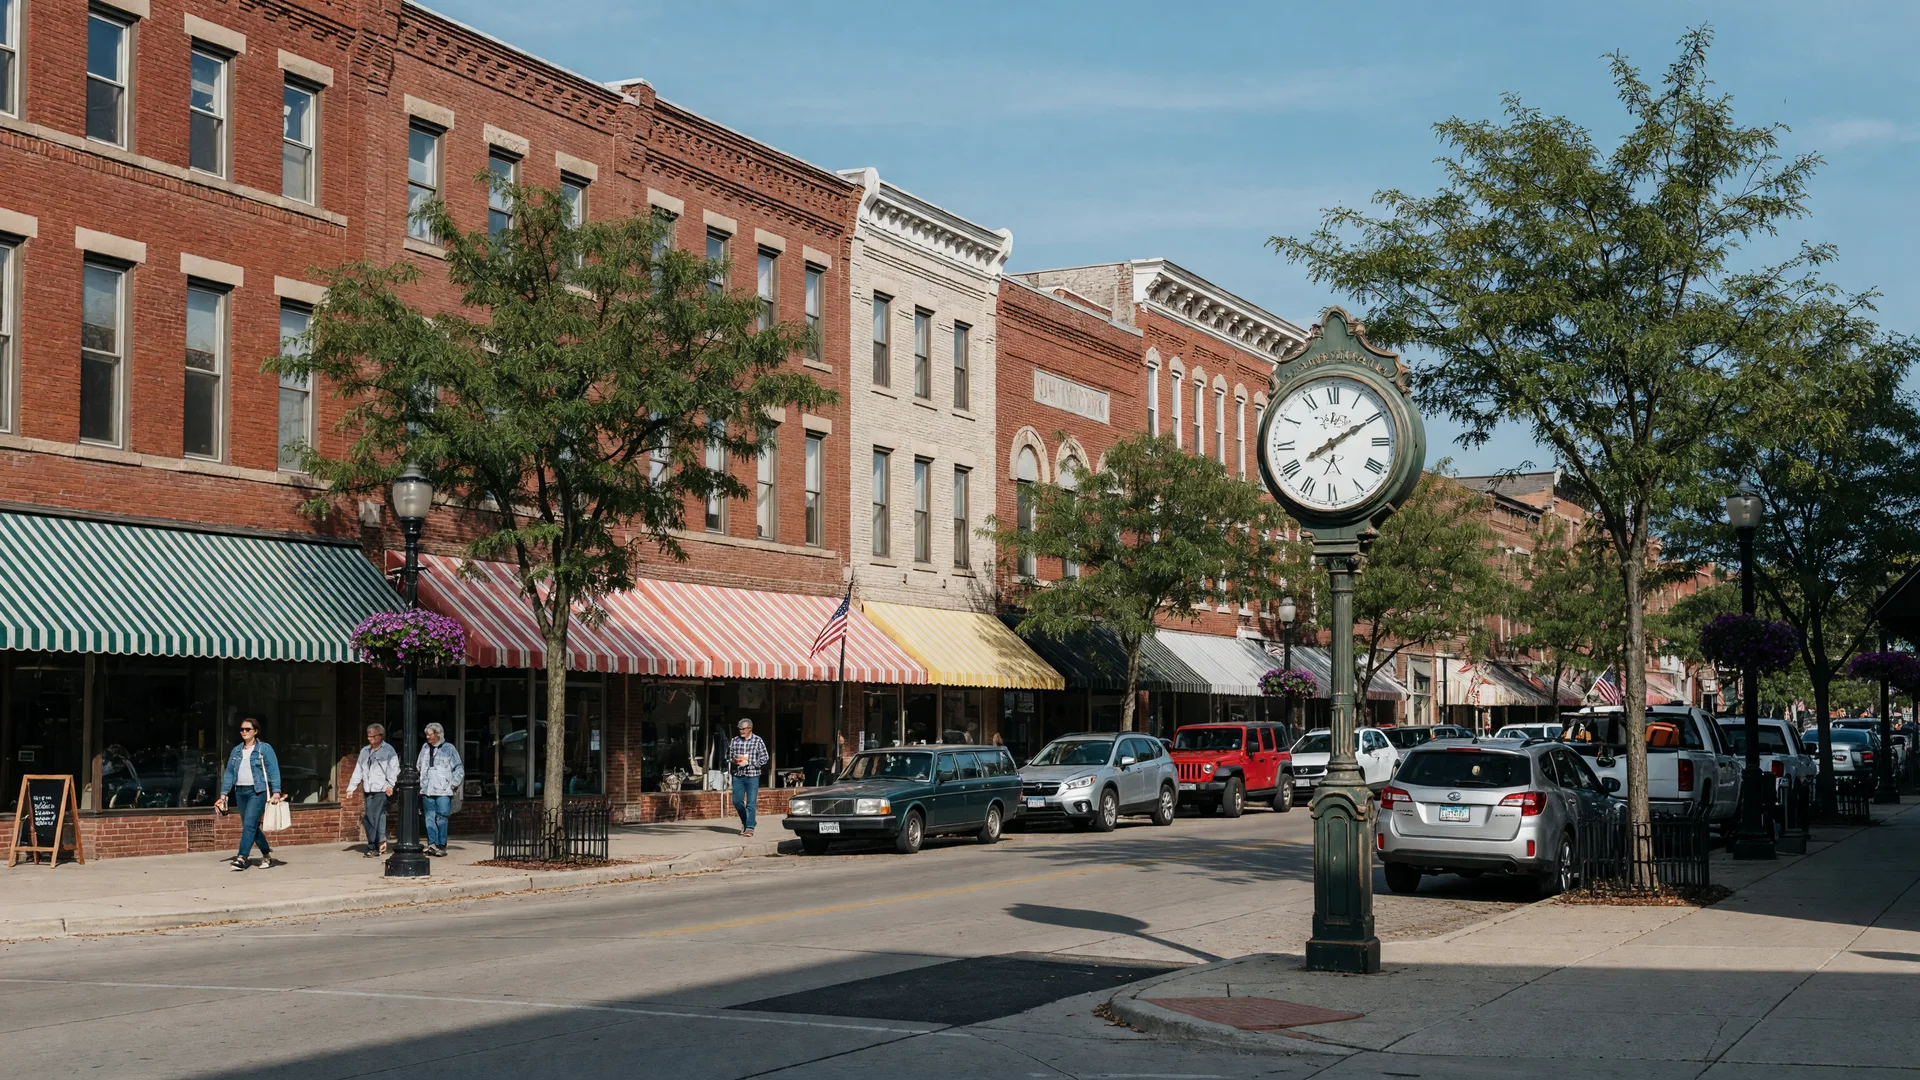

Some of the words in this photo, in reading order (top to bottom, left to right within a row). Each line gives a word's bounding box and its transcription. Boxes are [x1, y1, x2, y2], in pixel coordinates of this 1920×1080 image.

[1302, 393, 1318, 413] XI
[1326, 387, 1340, 405] XII
[1352, 393, 1362, 410] I
[1365, 411, 1382, 424] II
[1372, 438, 1389, 446] III
